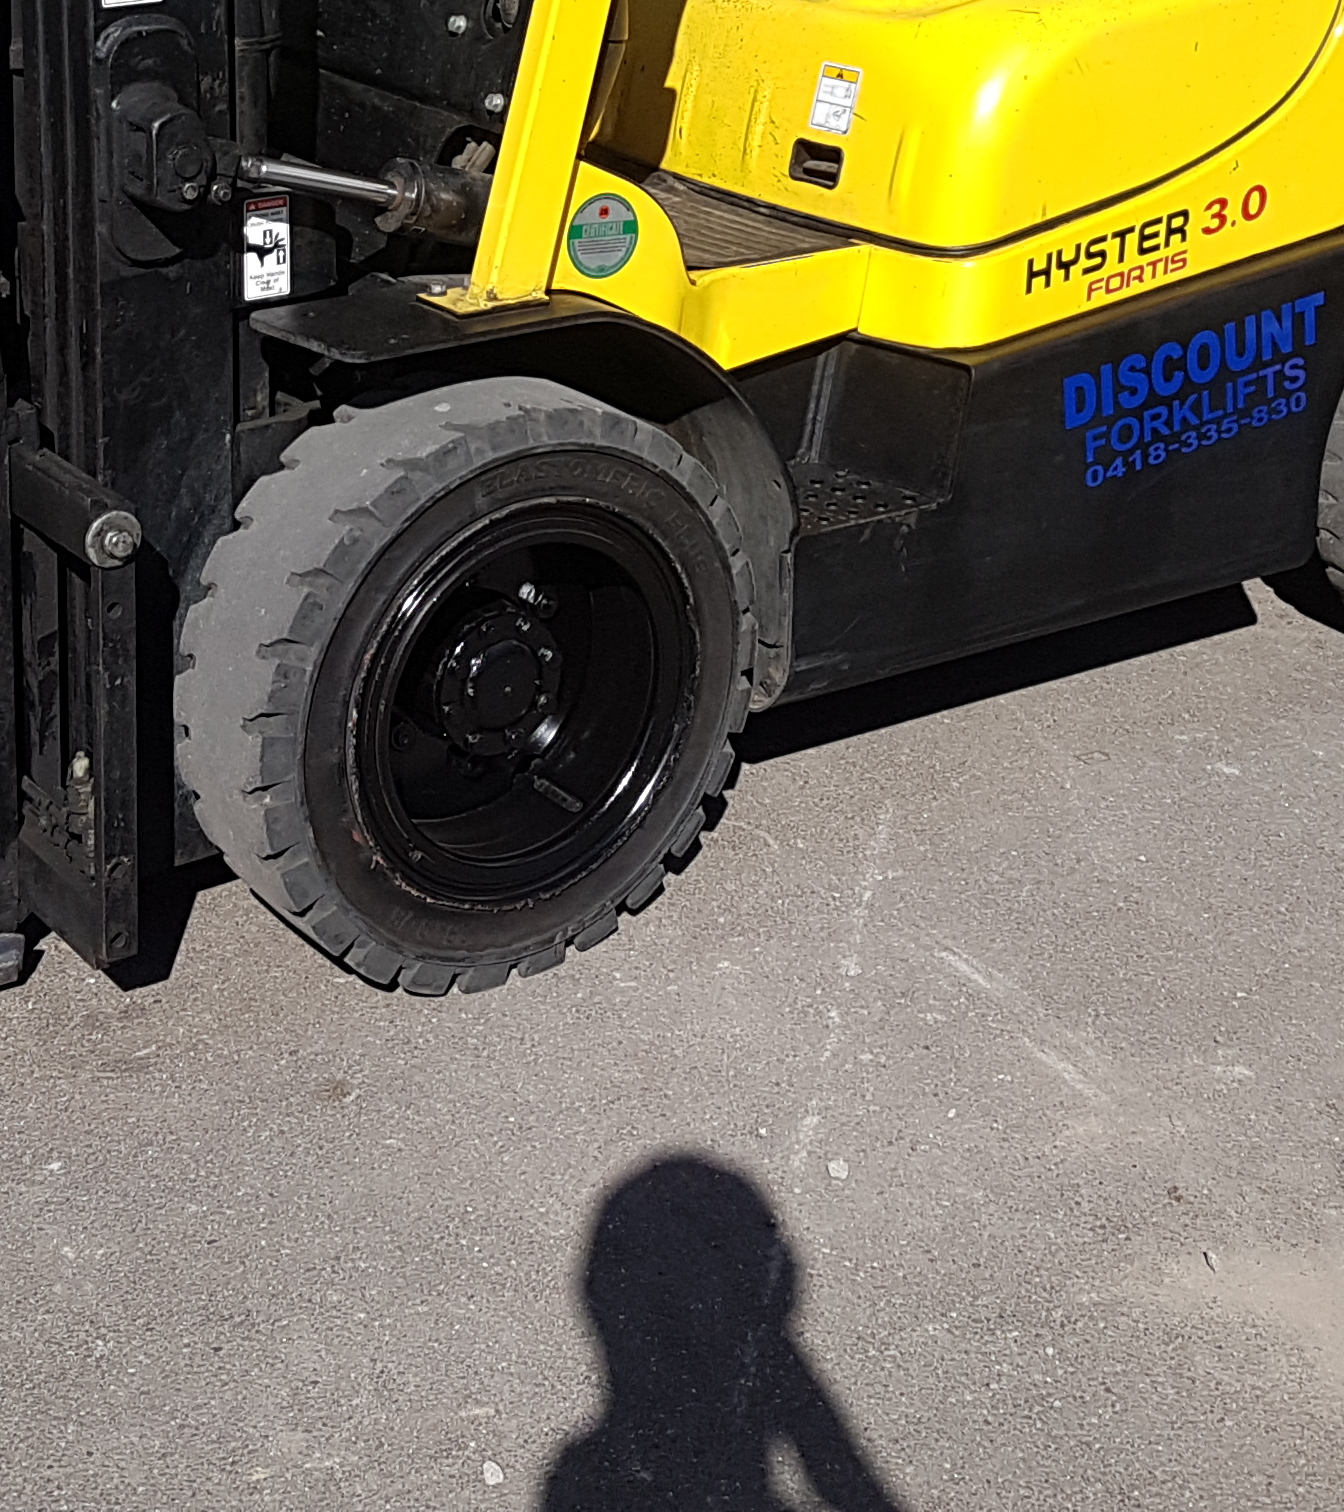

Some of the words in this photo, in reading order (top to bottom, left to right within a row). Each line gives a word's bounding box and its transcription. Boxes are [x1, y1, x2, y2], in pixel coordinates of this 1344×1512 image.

[1025, 209, 1190, 295] HYSTER
[1201, 184, 1268, 236] 3.0
[1086, 249, 1189, 302] FORTIS
[1062, 290, 1326, 430] DISCOUNT
[1085, 357, 1306, 463] FORKLIFTS
[1085, 392, 1308, 488] 0418-335-830
